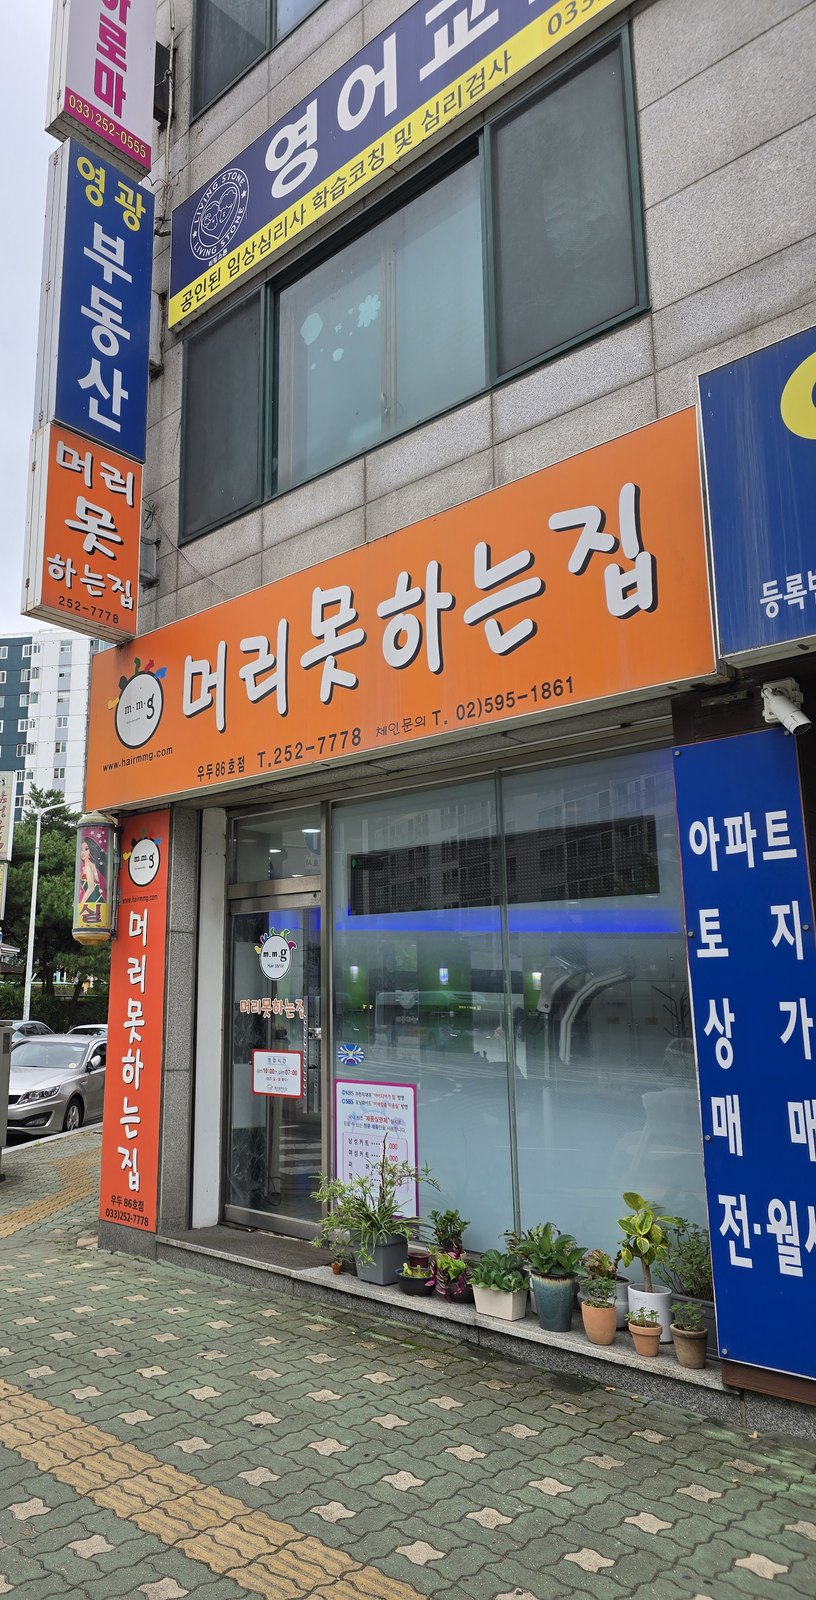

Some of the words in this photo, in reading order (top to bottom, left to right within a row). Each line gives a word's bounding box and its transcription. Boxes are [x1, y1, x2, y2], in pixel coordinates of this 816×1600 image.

[69, 94, 146, 159] 033)252-0555
[265, 0, 538, 199] 영어교
[76, 156, 147, 232] 영광
[180, 255, 222, 313] 공인된
[227, 196, 306, 279] 임상심리사
[312, 142, 386, 210] 학습코칭
[395, 122, 412, 154] 및
[421, 50, 512, 133] 심리검사
[194, 181, 219, 224] LIVING
[221, 171, 246, 187] STONE
[193, 241, 217, 257] LIVING
[220, 206, 245, 247] STONE
[80, 222, 133, 434] 부동산
[56, 440, 135, 508] 머리
[64, 495, 124, 560] 못
[46, 554, 135, 611] 하는집
[58, 595, 119, 625] 252-7778
[181, 482, 658, 735] 머리못하는집
[455, 676, 575, 721] 02)595-1861
[102, 746, 173, 772] www.hairmmg.com
[688, 808, 798, 873] 아파트
[105, 1208, 149, 1227] 033)252-7778
